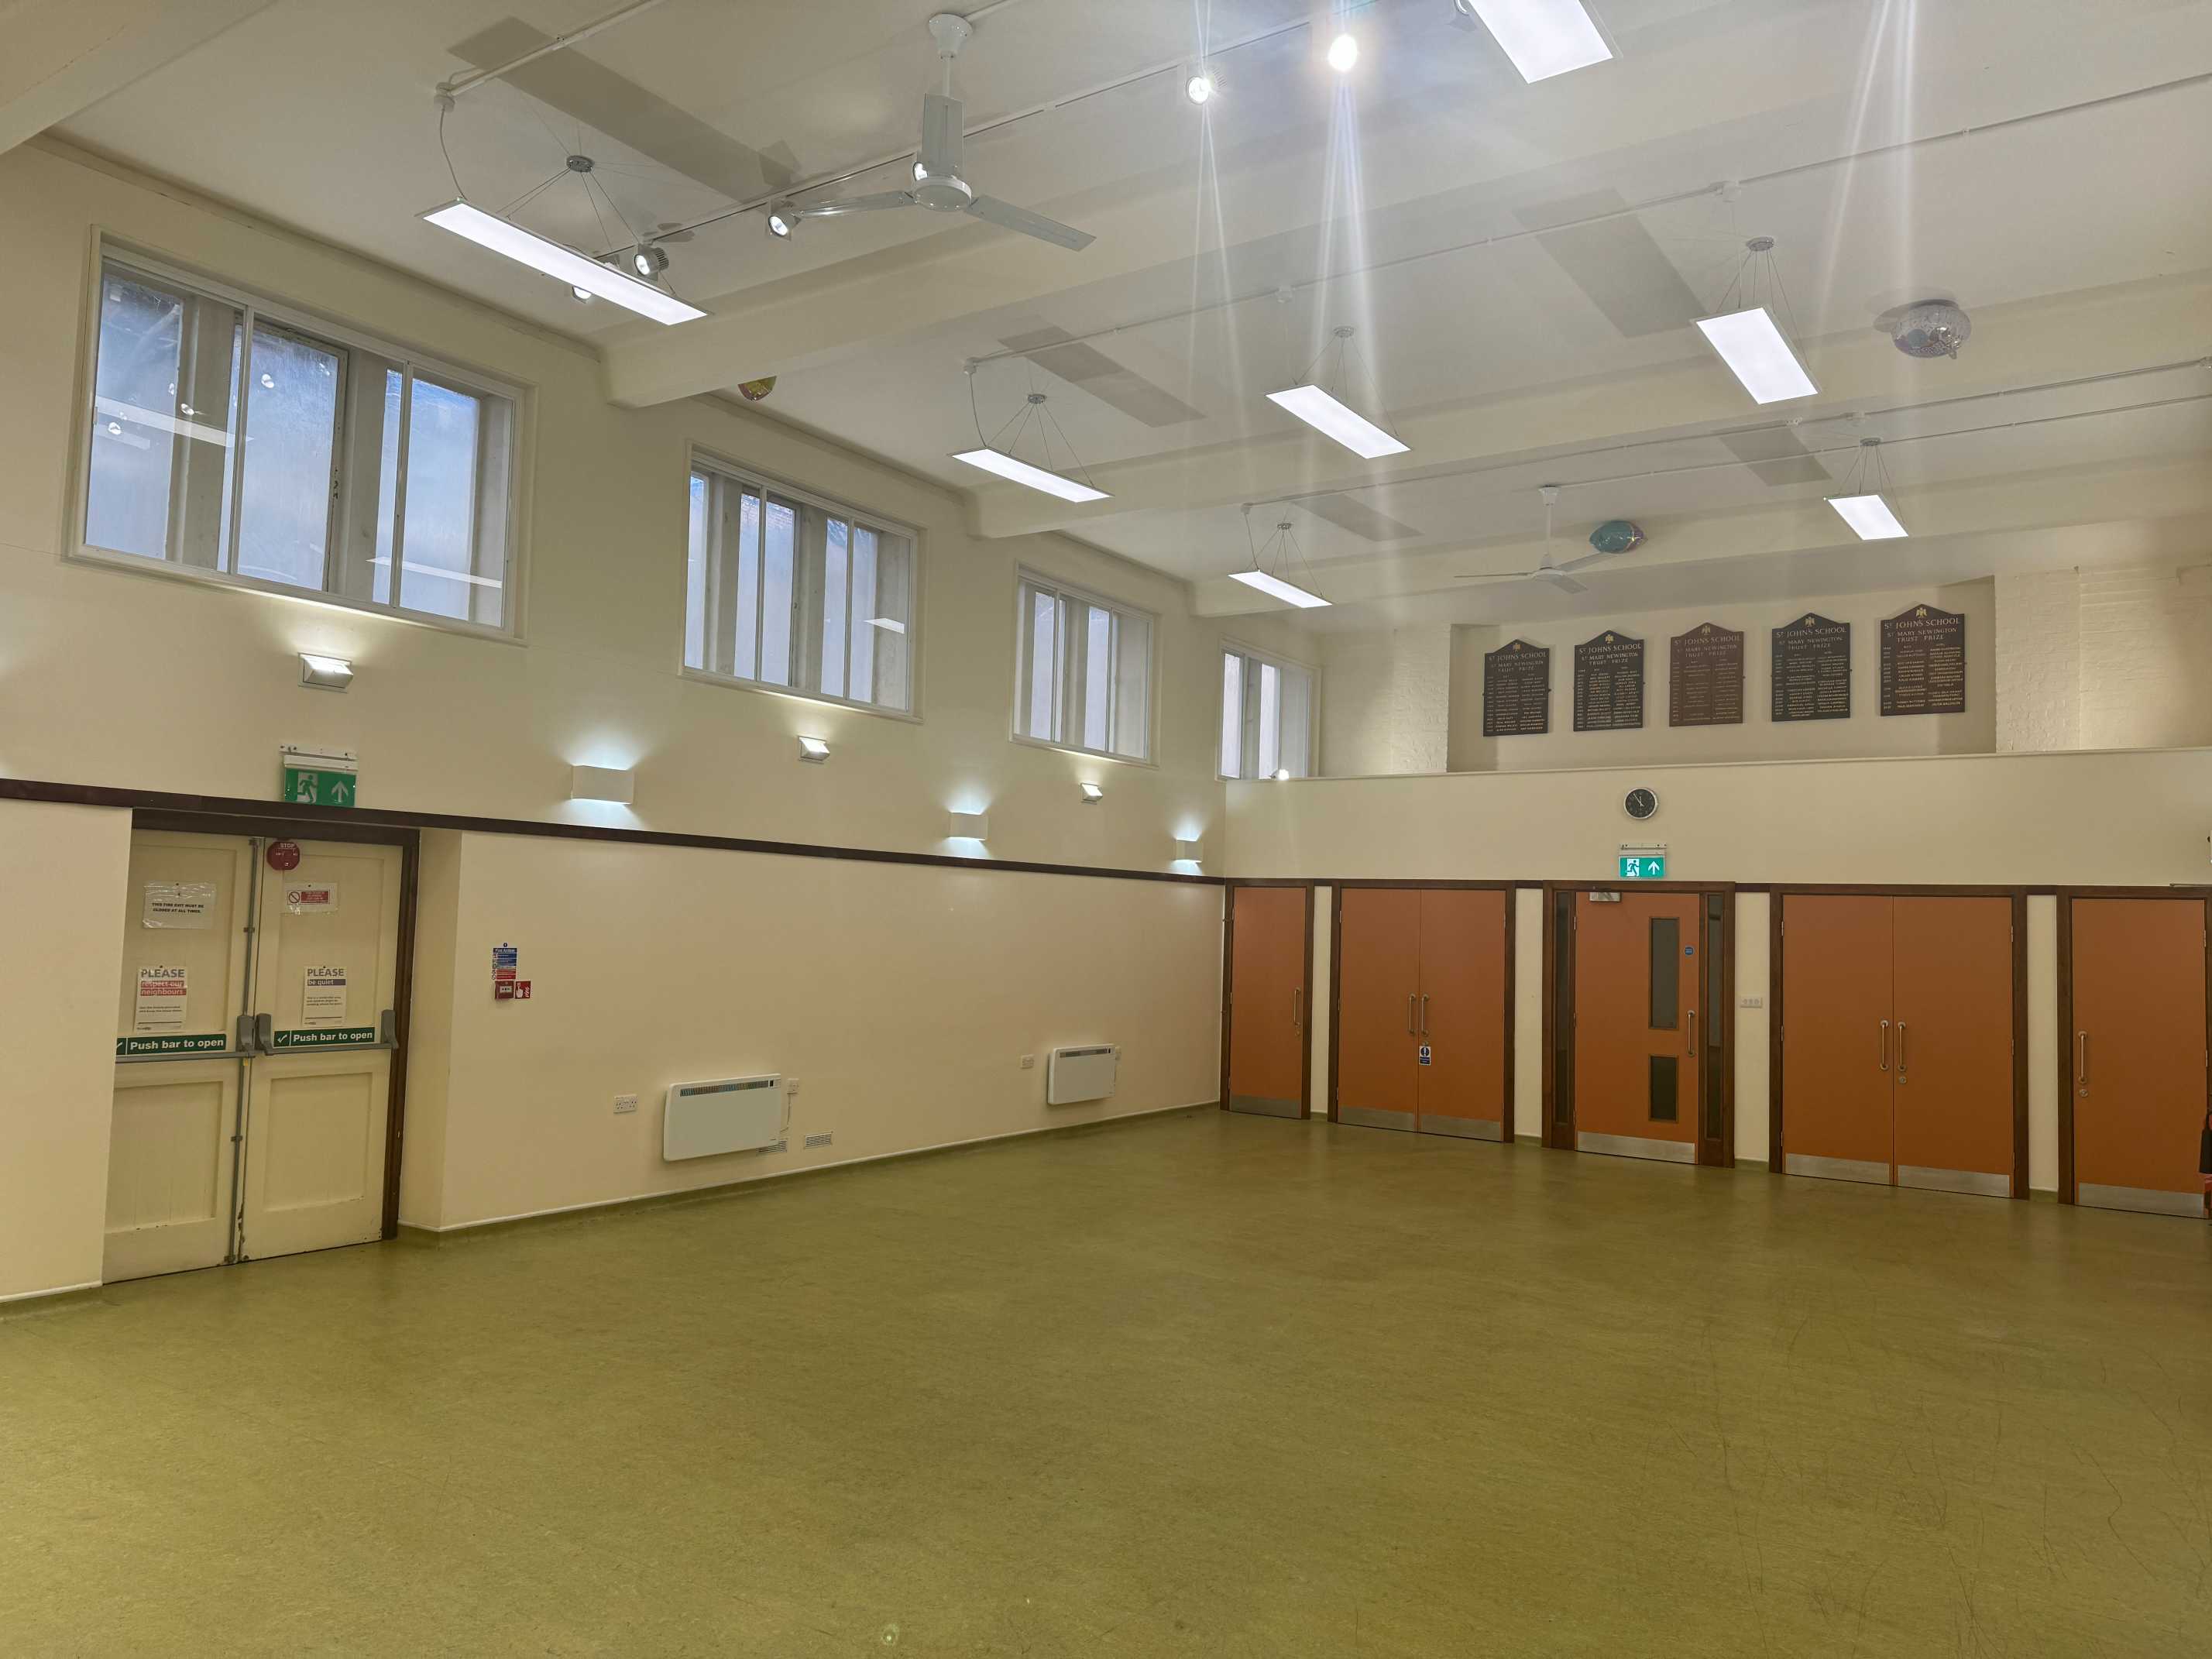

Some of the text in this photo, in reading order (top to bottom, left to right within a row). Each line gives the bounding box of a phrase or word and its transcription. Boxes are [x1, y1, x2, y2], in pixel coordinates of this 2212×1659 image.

[1925, 617, 1960, 626] SCHOOL
[1711, 635, 1741, 644] SCHOOL
[141, 969, 185, 978] PLEASE
[307, 968, 345, 977] PLEASE
[350, 1032, 373, 1041] open
[130, 1041, 159, 1050] Push
[161, 1040, 180, 1049] bar
[198, 1039, 224, 1049] open
